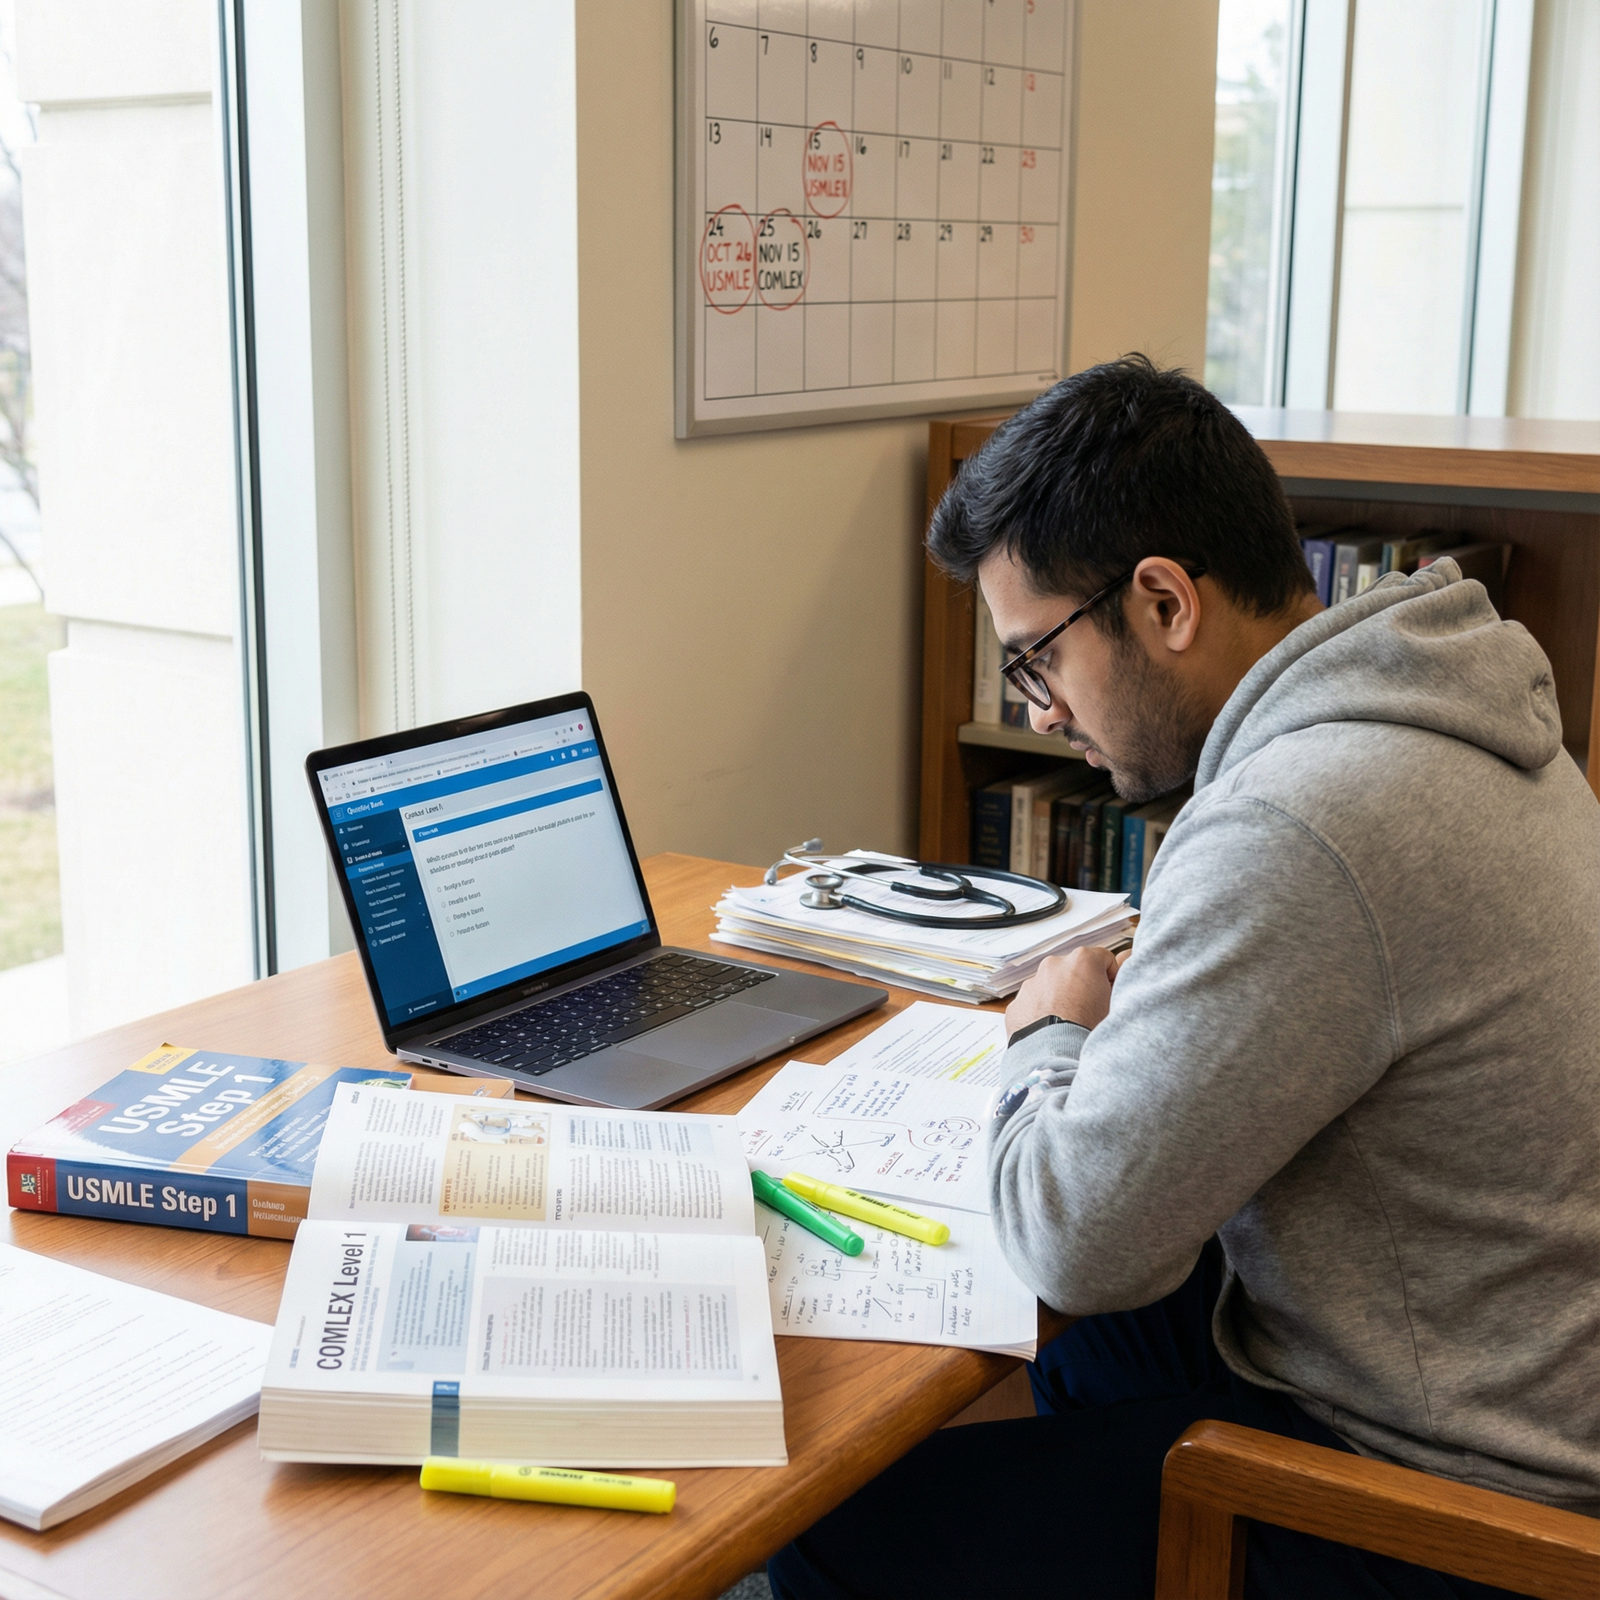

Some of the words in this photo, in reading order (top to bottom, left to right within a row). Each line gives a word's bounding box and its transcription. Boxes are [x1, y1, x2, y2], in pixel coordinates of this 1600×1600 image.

[709, 26, 719, 48] 6
[760, 35, 769, 56] 7
[810, 42, 818, 63] 8
[856, 48, 865, 70] 9
[709, 122, 722, 144] 13
[760, 127, 773, 148] 14
[809, 132, 822, 150] 15
[855, 136, 867, 155] 16
[808, 153, 830, 172] NOV
[834, 153, 845, 173] 15
[708, 217, 724, 237] 24
[759, 218, 775, 237] 25
[807, 220, 822, 239] 26
[853, 221, 868, 240] 27
[897, 223, 911, 241] 28
[939, 224, 953, 242] 29
[707, 242, 731, 263] OCT
[736, 241, 752, 262] 26
[759, 242, 783, 263] NOV
[788, 242, 800, 262] 15
[707, 269, 751, 292] USMLE
[757, 269, 804, 291] COMLEX
[98, 1061, 235, 1134] USMLE
[156, 1089, 255, 1137] Step
[234, 1073, 276, 1084] 1
[67, 1175, 155, 1209] USMLE
[161, 1185, 217, 1222] Step
[225, 1193, 237, 1218] 1
[333, 1243, 365, 1286] Level
[316, 1292, 356, 1370] COMLEX
